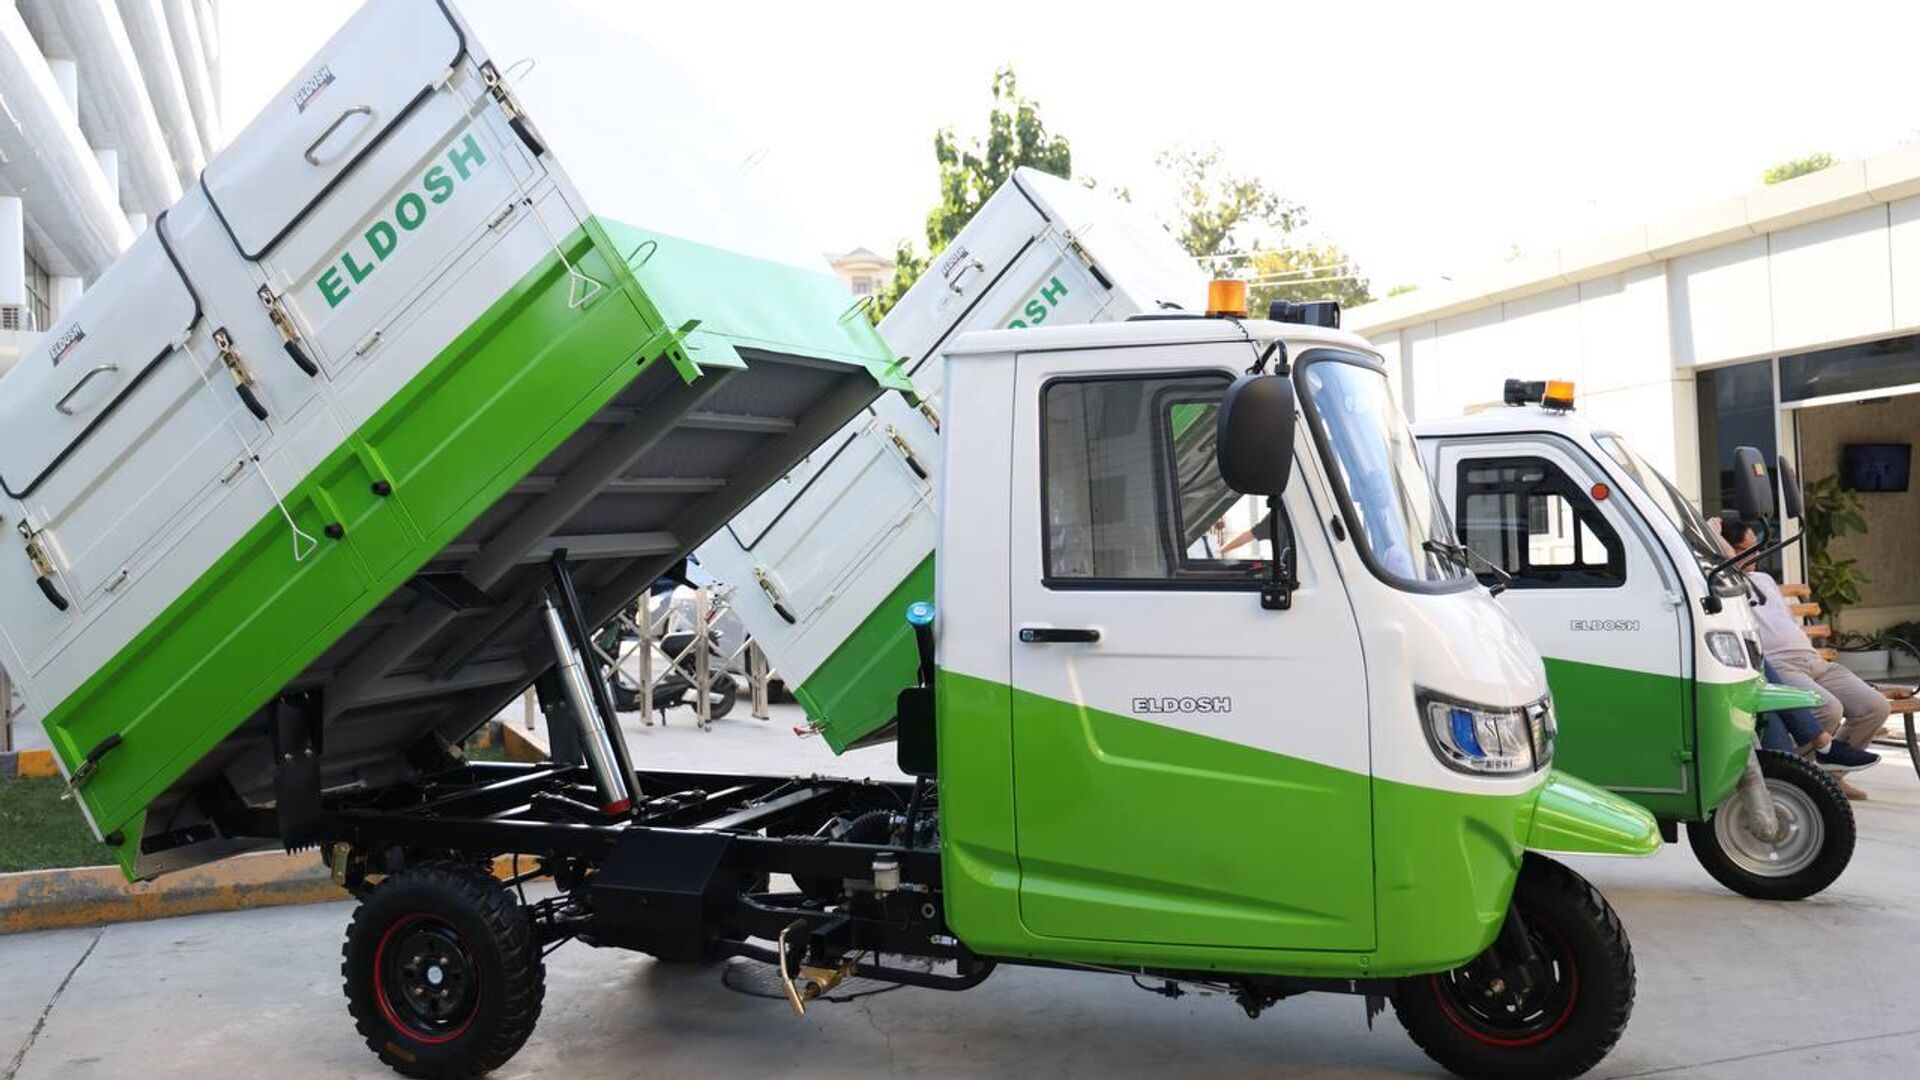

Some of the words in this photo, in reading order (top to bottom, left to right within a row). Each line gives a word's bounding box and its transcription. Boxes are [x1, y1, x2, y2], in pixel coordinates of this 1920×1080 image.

[295, 65, 333, 107] ELDOSH
[316, 133, 487, 309] ELDOSH
[1570, 619, 1641, 632] ELDOSH
[1131, 696, 1232, 714] ELDOSH
